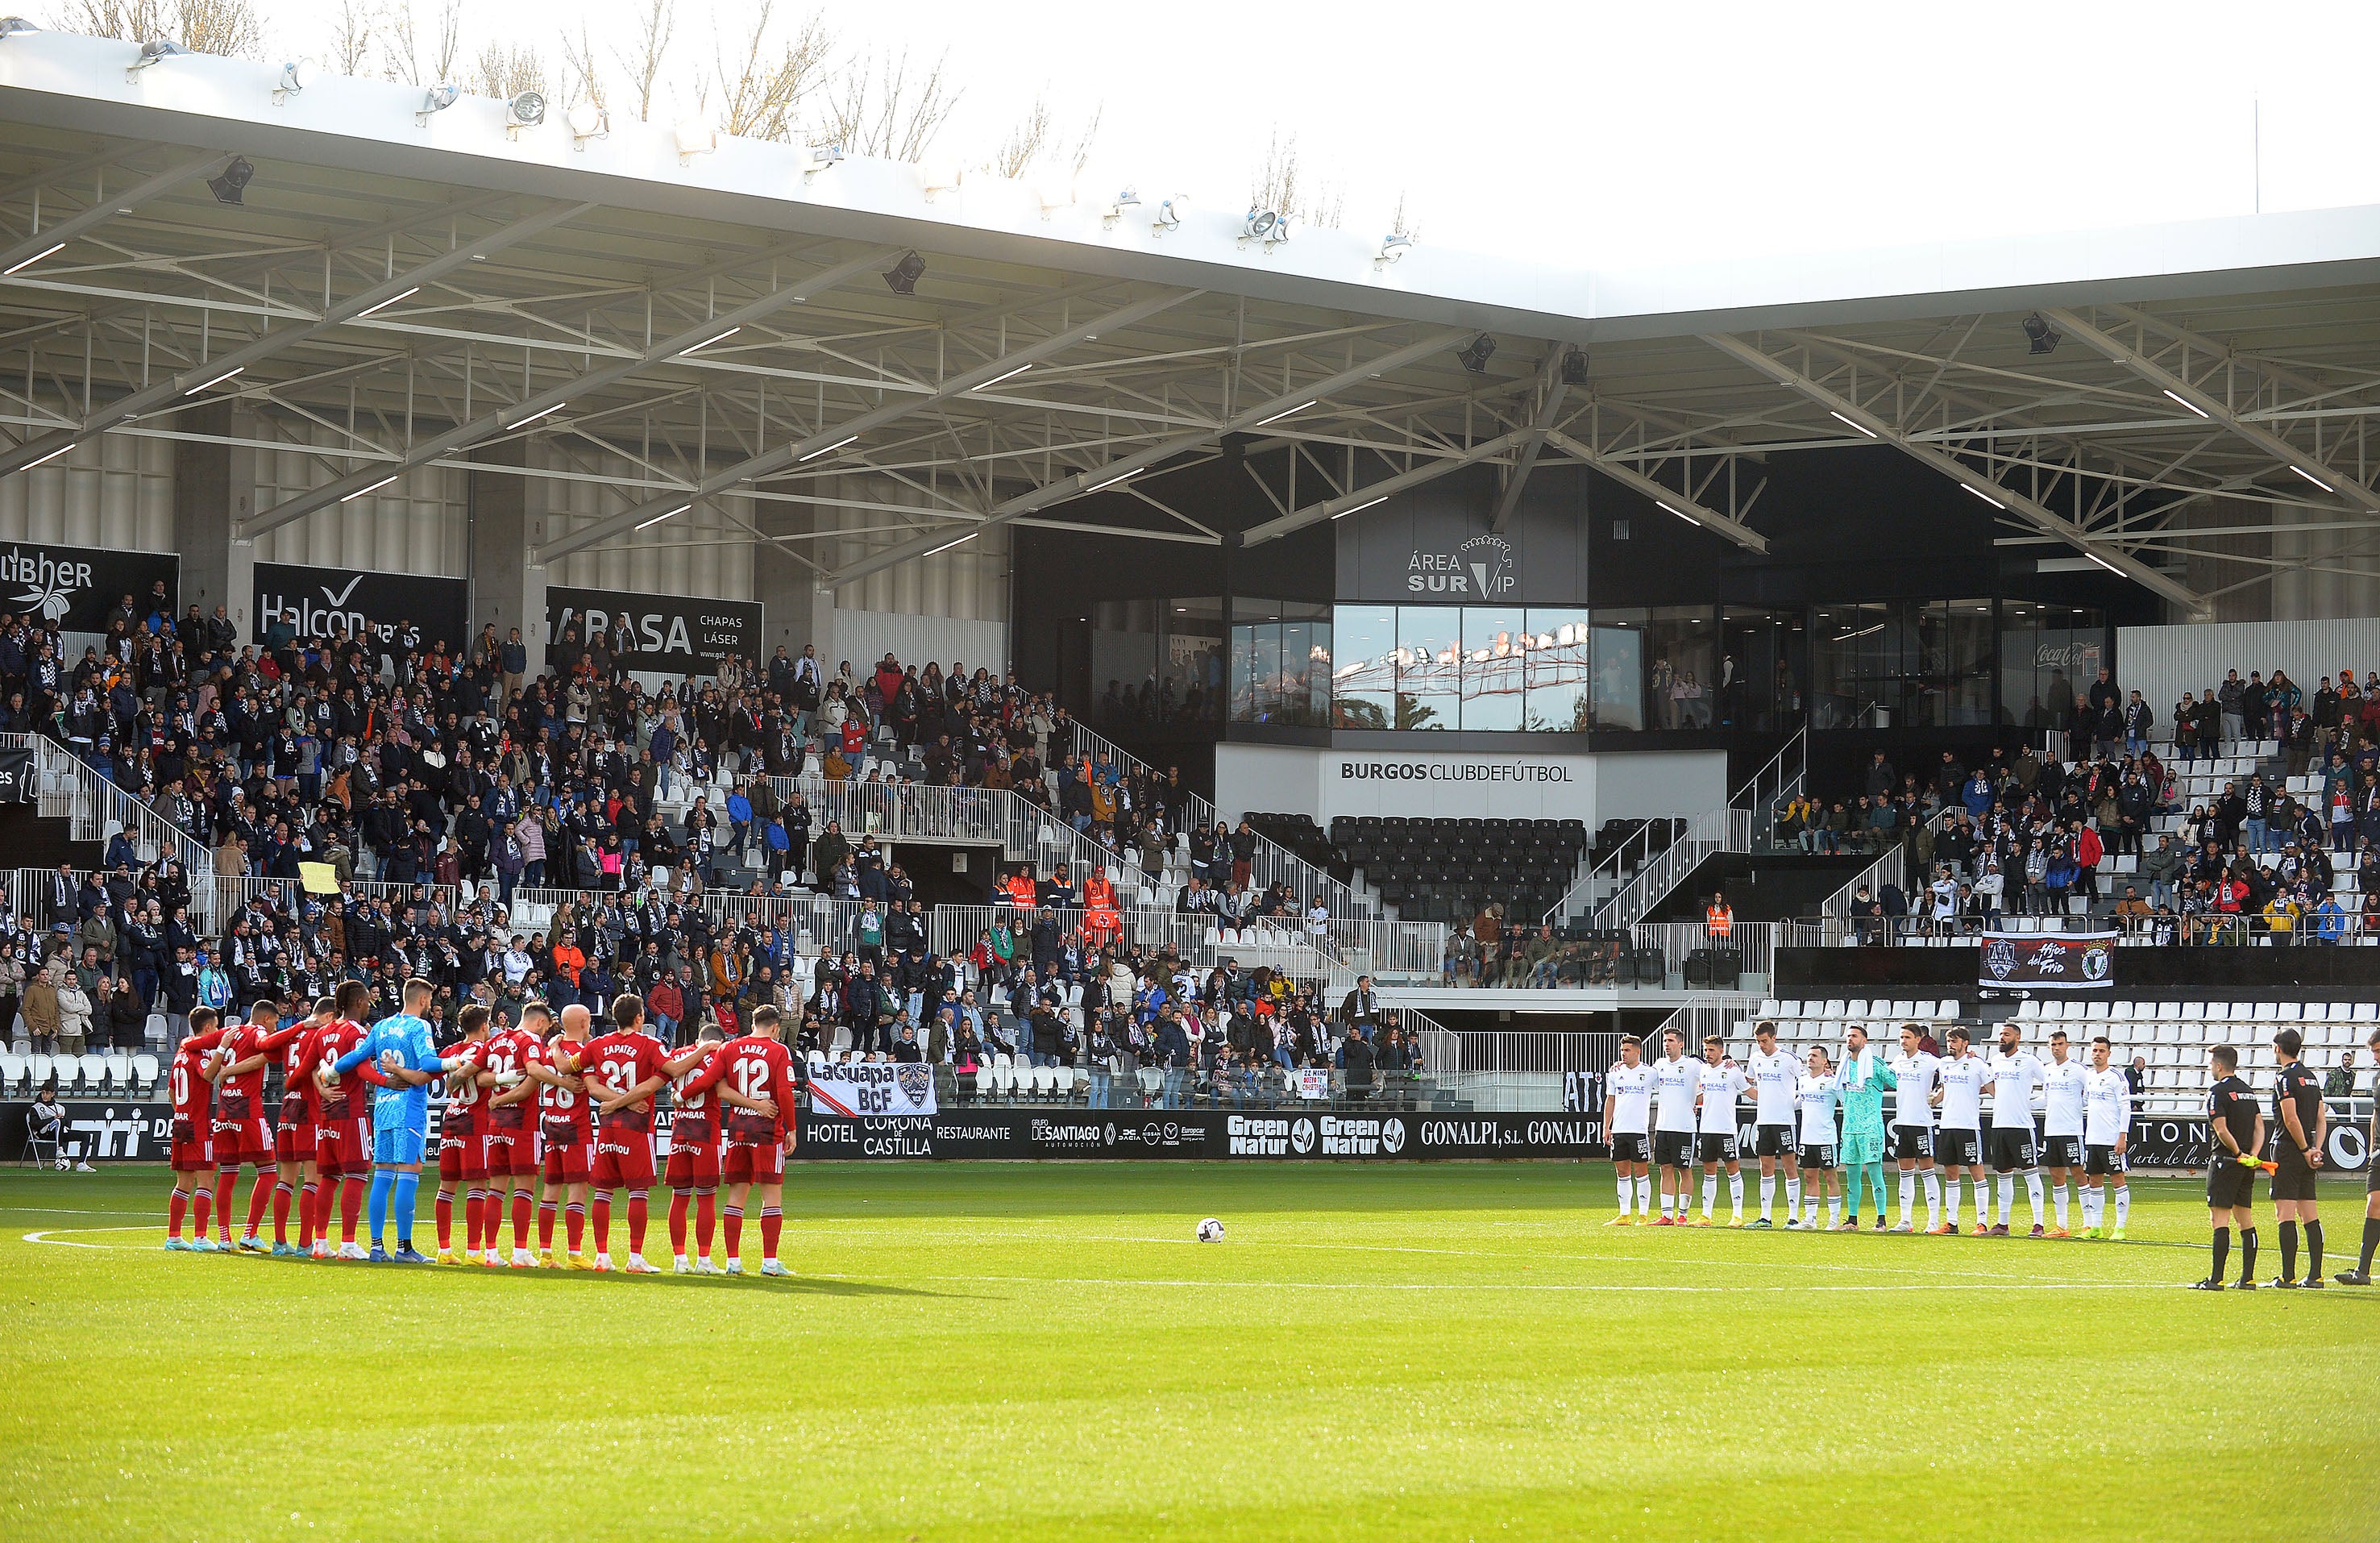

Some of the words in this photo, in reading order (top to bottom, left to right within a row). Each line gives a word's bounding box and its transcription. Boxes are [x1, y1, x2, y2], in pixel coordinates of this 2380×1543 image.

[1408, 550, 1461, 571] ÁREA
[1407, 575, 1468, 593] SUR
[700, 615, 742, 628] CHAPAS
[704, 633, 738, 645] LÁSER
[2038, 942, 2066, 958] Hijos
[2027, 954, 2040, 966] del
[2039, 959, 2065, 975] Frio
[603, 1045, 638, 1058] ZAPATER
[739, 1045, 768, 1058] LARRA
[600, 1060, 637, 1096] 21
[733, 1057, 770, 1100] 12
[858, 1087, 891, 1114] BCF
[864, 1117, 933, 1130] CORONA
[1181, 1126, 1206, 1135] Europcar
[1227, 1115, 1288, 1136] Green
[1319, 1115, 1379, 1136] Green
[807, 1125, 858, 1143] HOTEL
[937, 1126, 1011, 1141] RESTAURANTE
[1420, 1121, 1502, 1149] GONALPI,
[1504, 1129, 1524, 1145] S.L.
[863, 1137, 932, 1155] CASTILLA
[1229, 1135, 1287, 1155] Natur
[1322, 1135, 1377, 1155] Natur
[2133, 1150, 2162, 1165] arte
[2163, 1143, 2183, 1164] de
[2184, 1143, 2202, 1165] la
